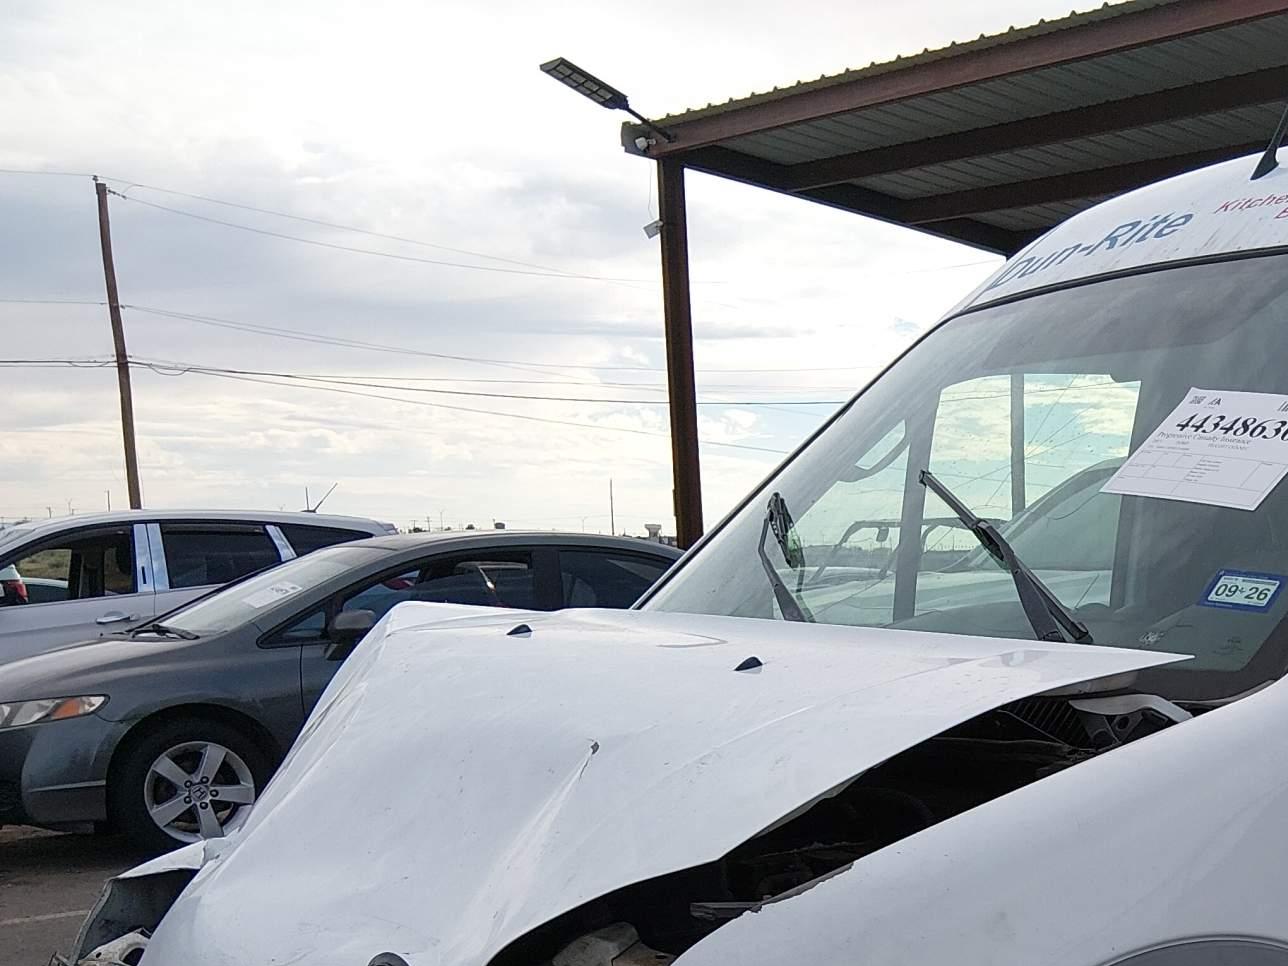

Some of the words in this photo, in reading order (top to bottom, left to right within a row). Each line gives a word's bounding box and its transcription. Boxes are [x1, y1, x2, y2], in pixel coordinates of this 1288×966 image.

[990, 211, 1194, 288] Dun-Rite
[1214, 583, 1239, 598] 09
[1244, 586, 1272, 601] 26
